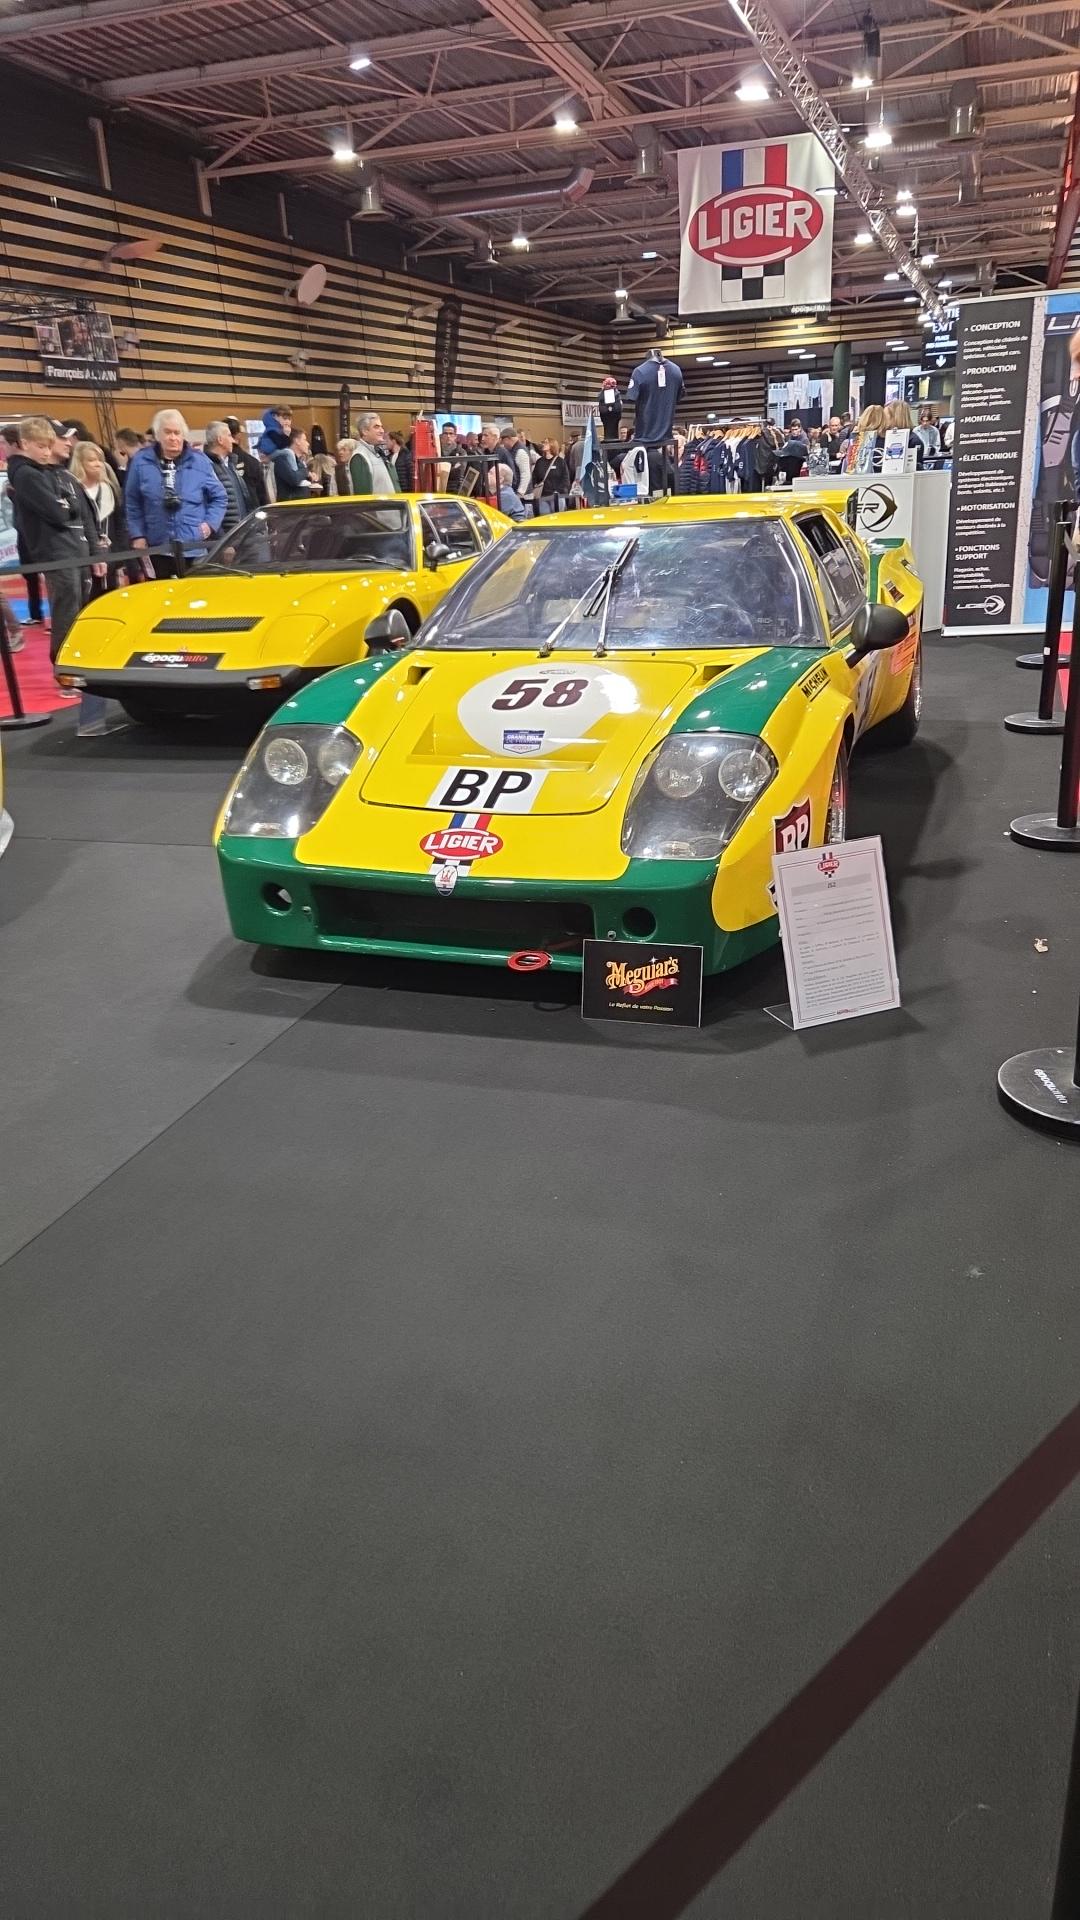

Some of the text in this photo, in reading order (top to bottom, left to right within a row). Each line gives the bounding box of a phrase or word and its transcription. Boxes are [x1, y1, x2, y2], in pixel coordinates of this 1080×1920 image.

[698, 200, 813, 250] LIGIER
[970, 321, 1021, 332] CONCEPTION
[47, 365, 84, 380] François
[966, 364, 1017, 375] PRODUCTION
[964, 414, 1001, 423] MONTAGE
[962, 451, 1019, 462] ÉLECTRONIQUE
[960, 502, 1015, 512] MOTORISATION
[958, 544, 1000, 552] FONCTIONS
[955, 552, 989, 561] SUPPORT
[802, 666, 830, 698] MICHELIN
[491, 679, 589, 711] 58
[439, 769, 533, 809] BP
[780, 814, 809, 852] BP
[424, 834, 499, 854] LIGIER
[605, 957, 680, 993] Meguiar's
